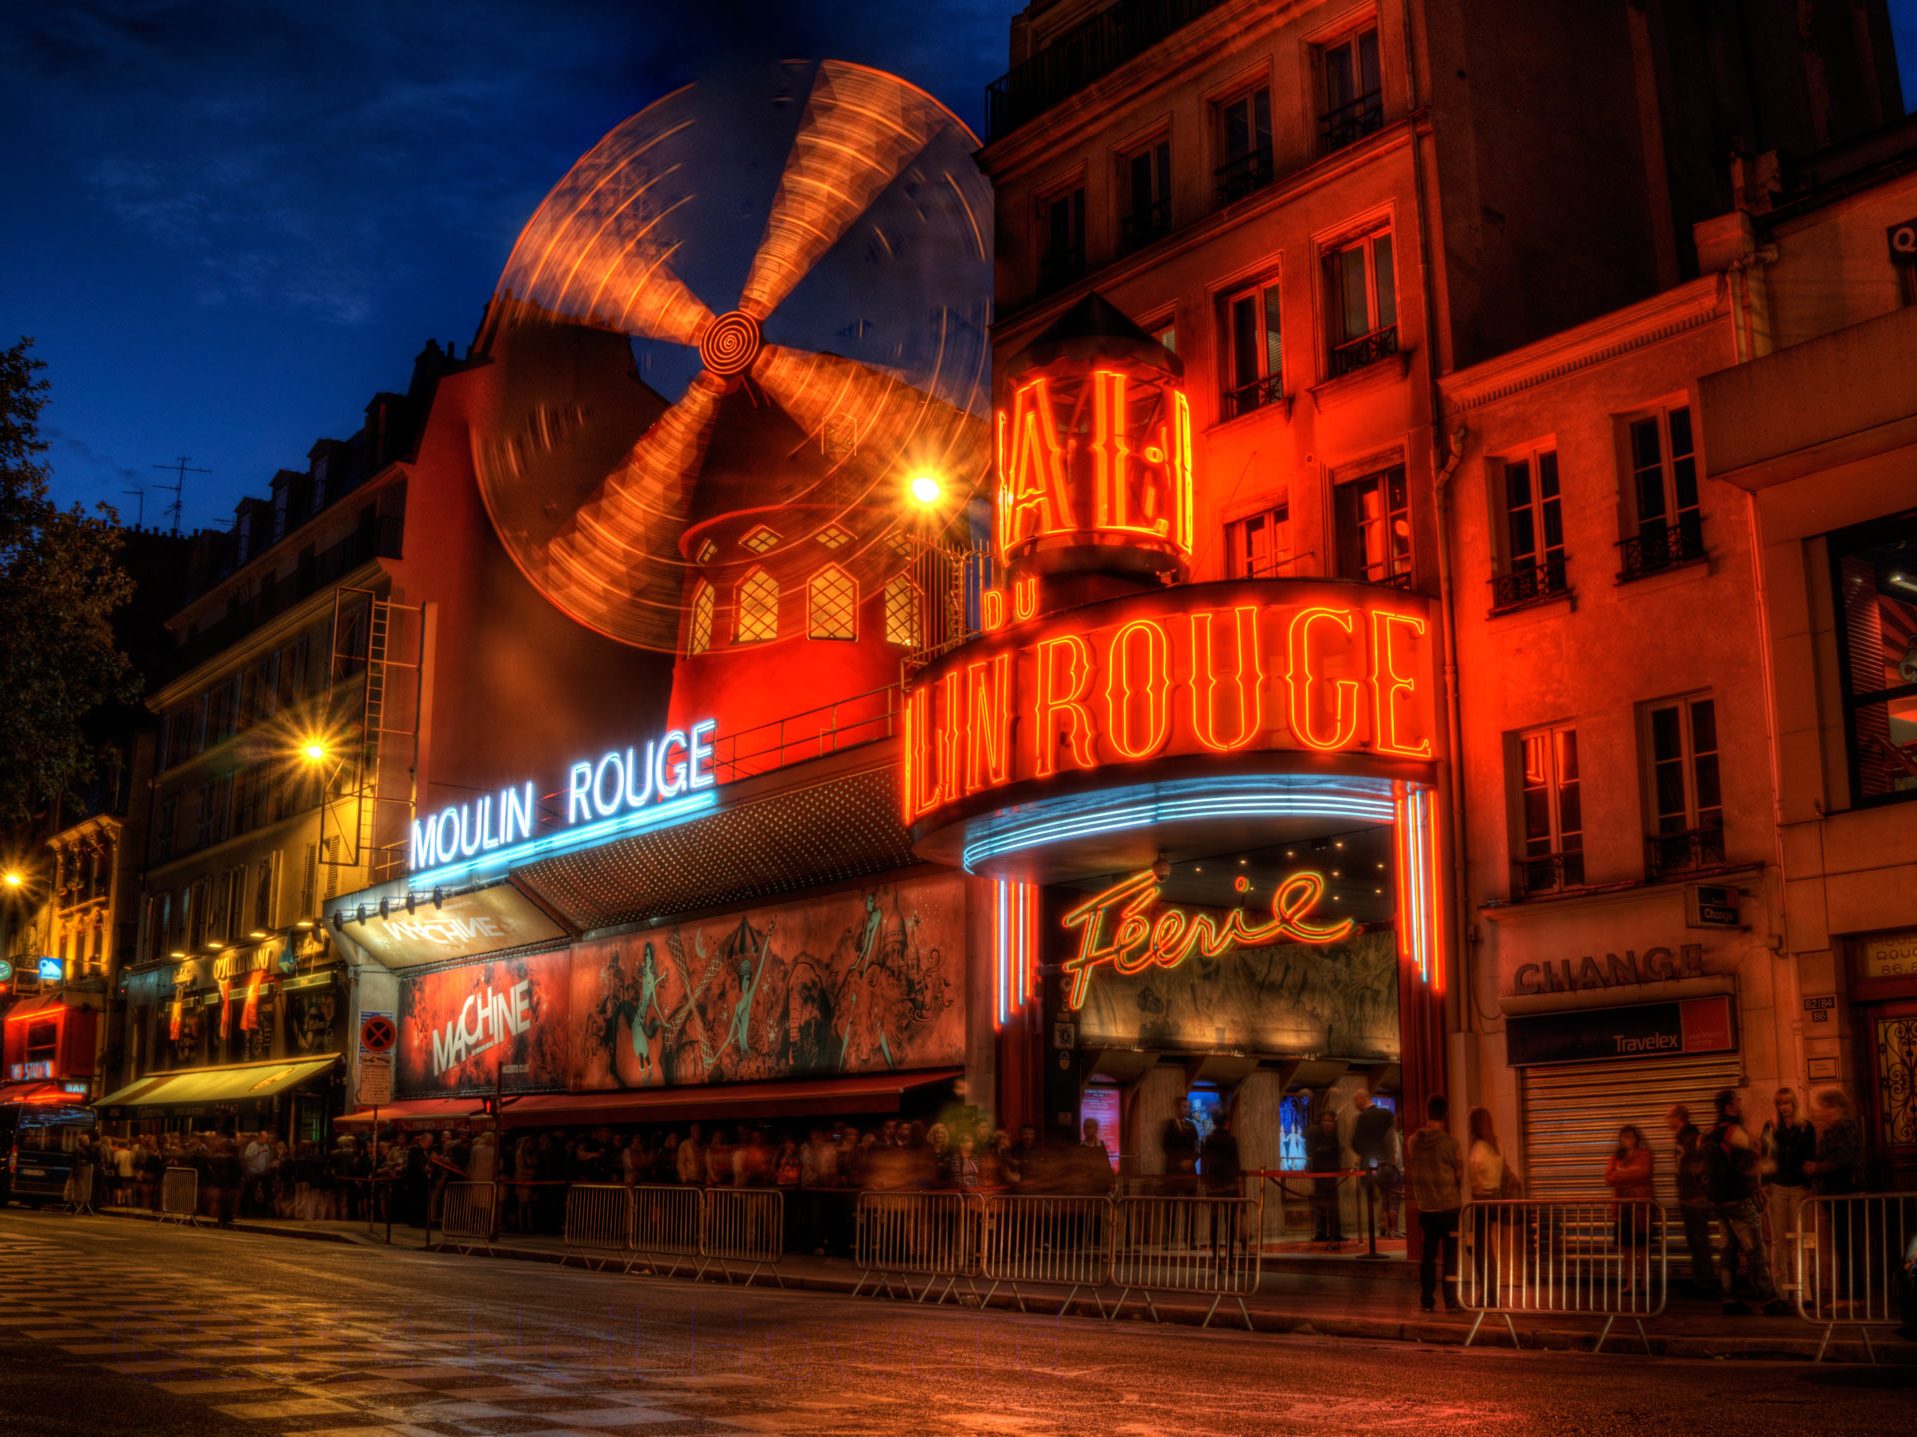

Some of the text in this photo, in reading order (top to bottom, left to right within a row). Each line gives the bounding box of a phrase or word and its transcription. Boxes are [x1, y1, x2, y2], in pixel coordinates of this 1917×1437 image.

[983, 577, 1037, 631] DU
[904, 605, 1433, 825] LIN ROUGE
[409, 718, 718, 871] MOULIN ROUGE
[1514, 943, 1704, 995] CHANGE
[432, 979, 532, 1077] MACHINE
[1612, 1031, 1679, 1054] Travelex
